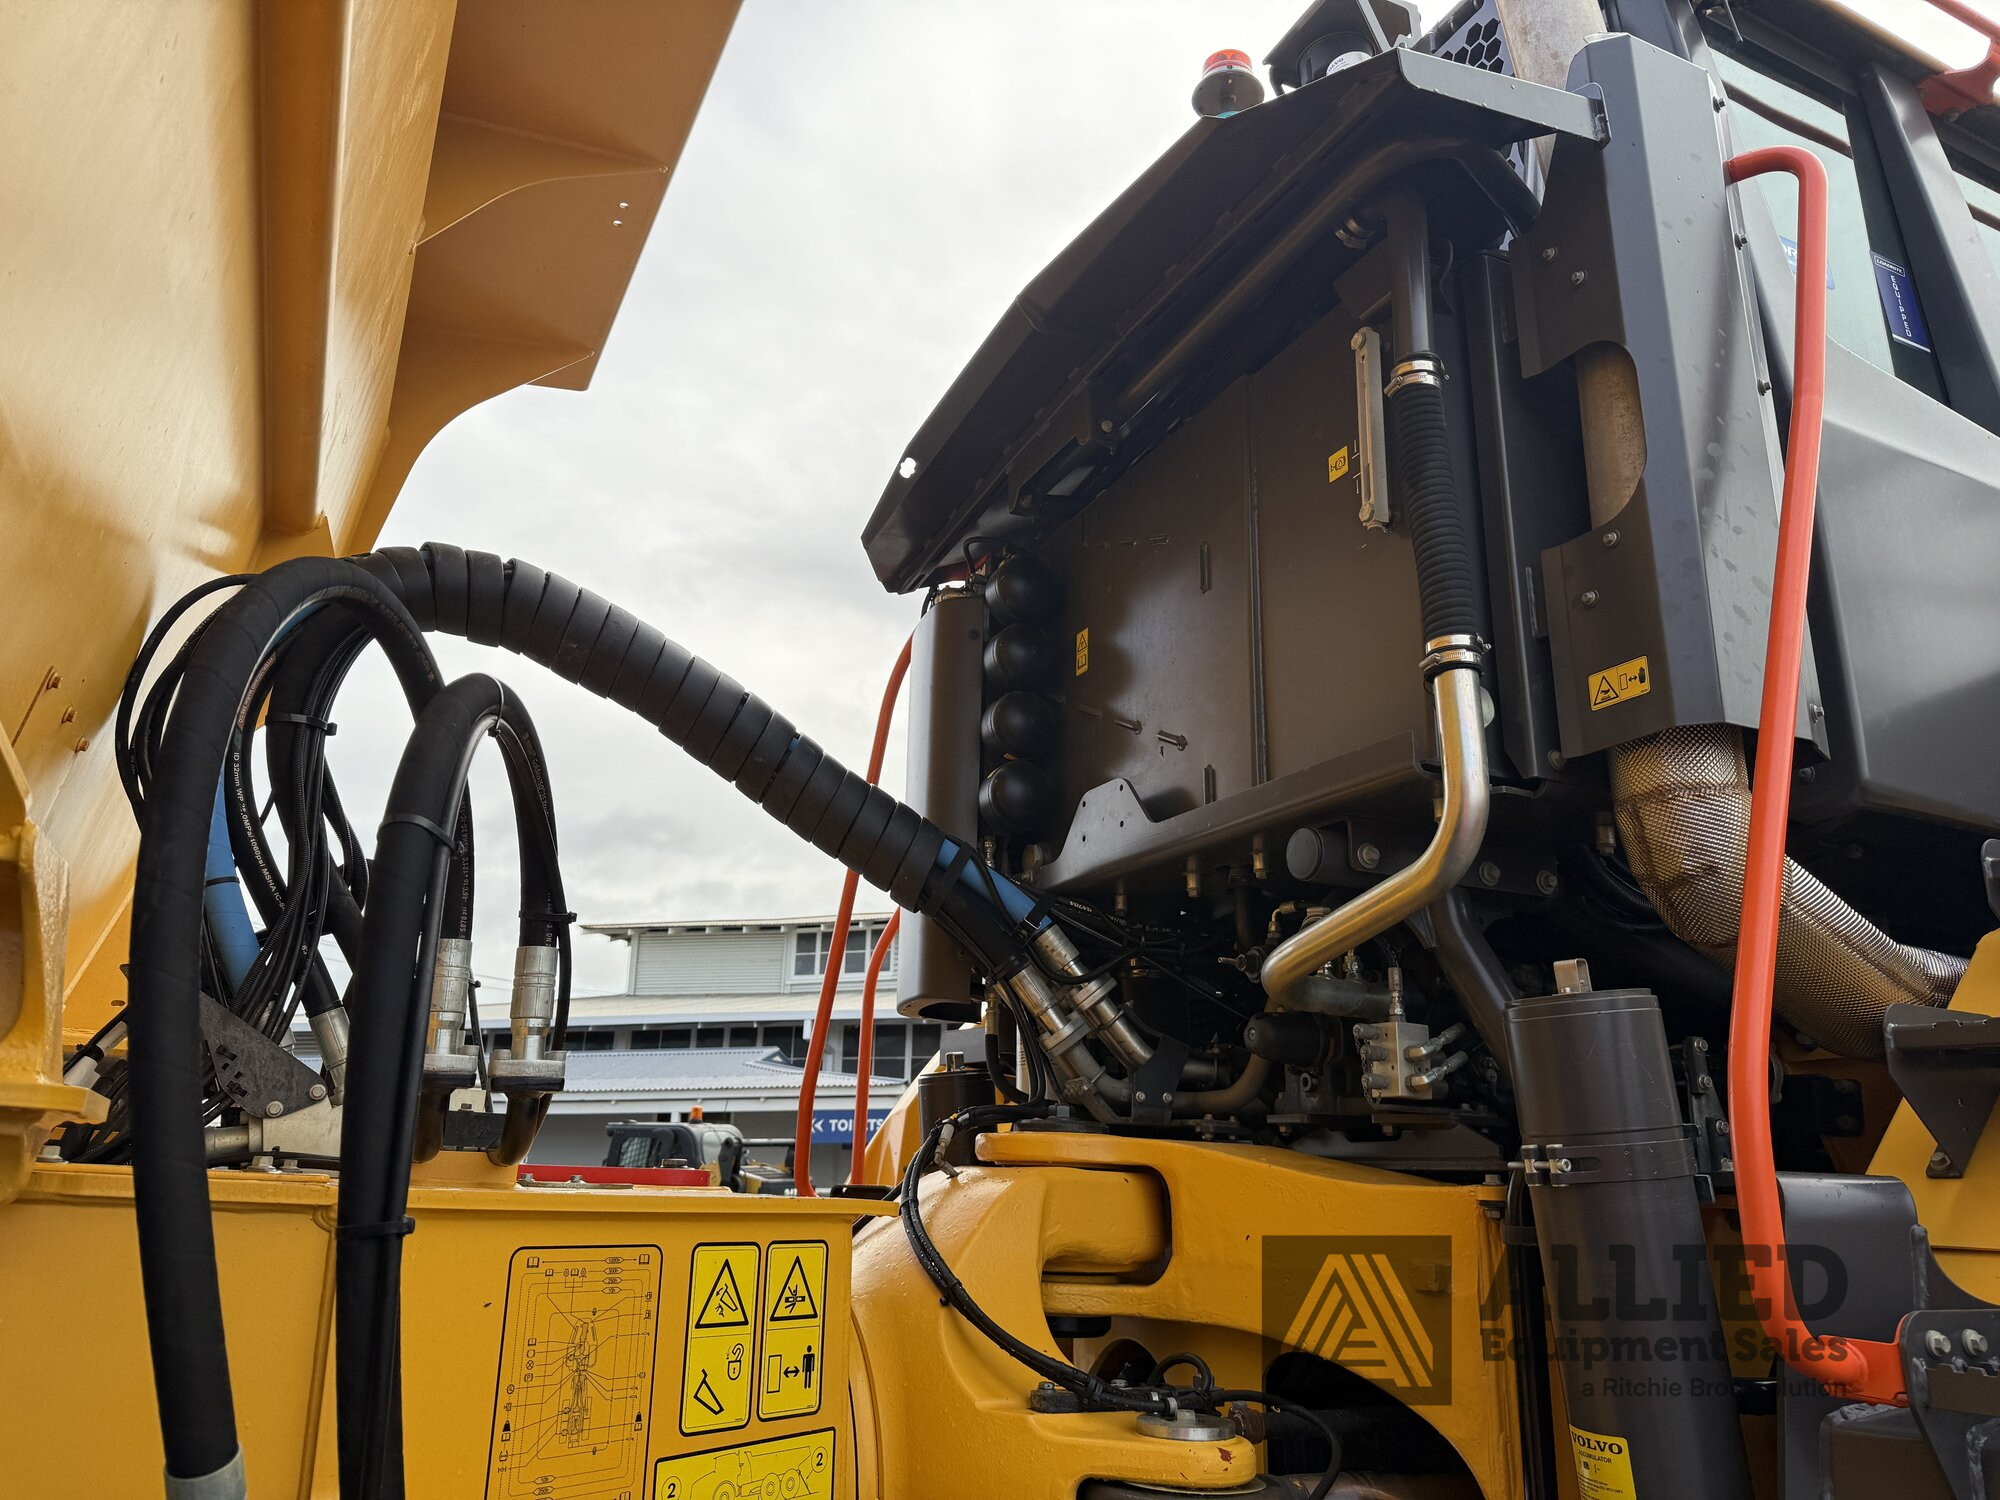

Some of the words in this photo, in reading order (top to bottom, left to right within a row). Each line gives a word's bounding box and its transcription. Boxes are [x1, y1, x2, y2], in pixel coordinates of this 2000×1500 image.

[1890, 274, 1912, 338] EQUIPPED
[233, 752, 240, 761] ID
[261, 868, 278, 892] MSHA
[829, 1118, 884, 1132] TOITS
[1571, 1431, 1623, 1455] VOLVO
[815, 1452, 824, 1466] 2
[666, 1482, 676, 1499] 2
